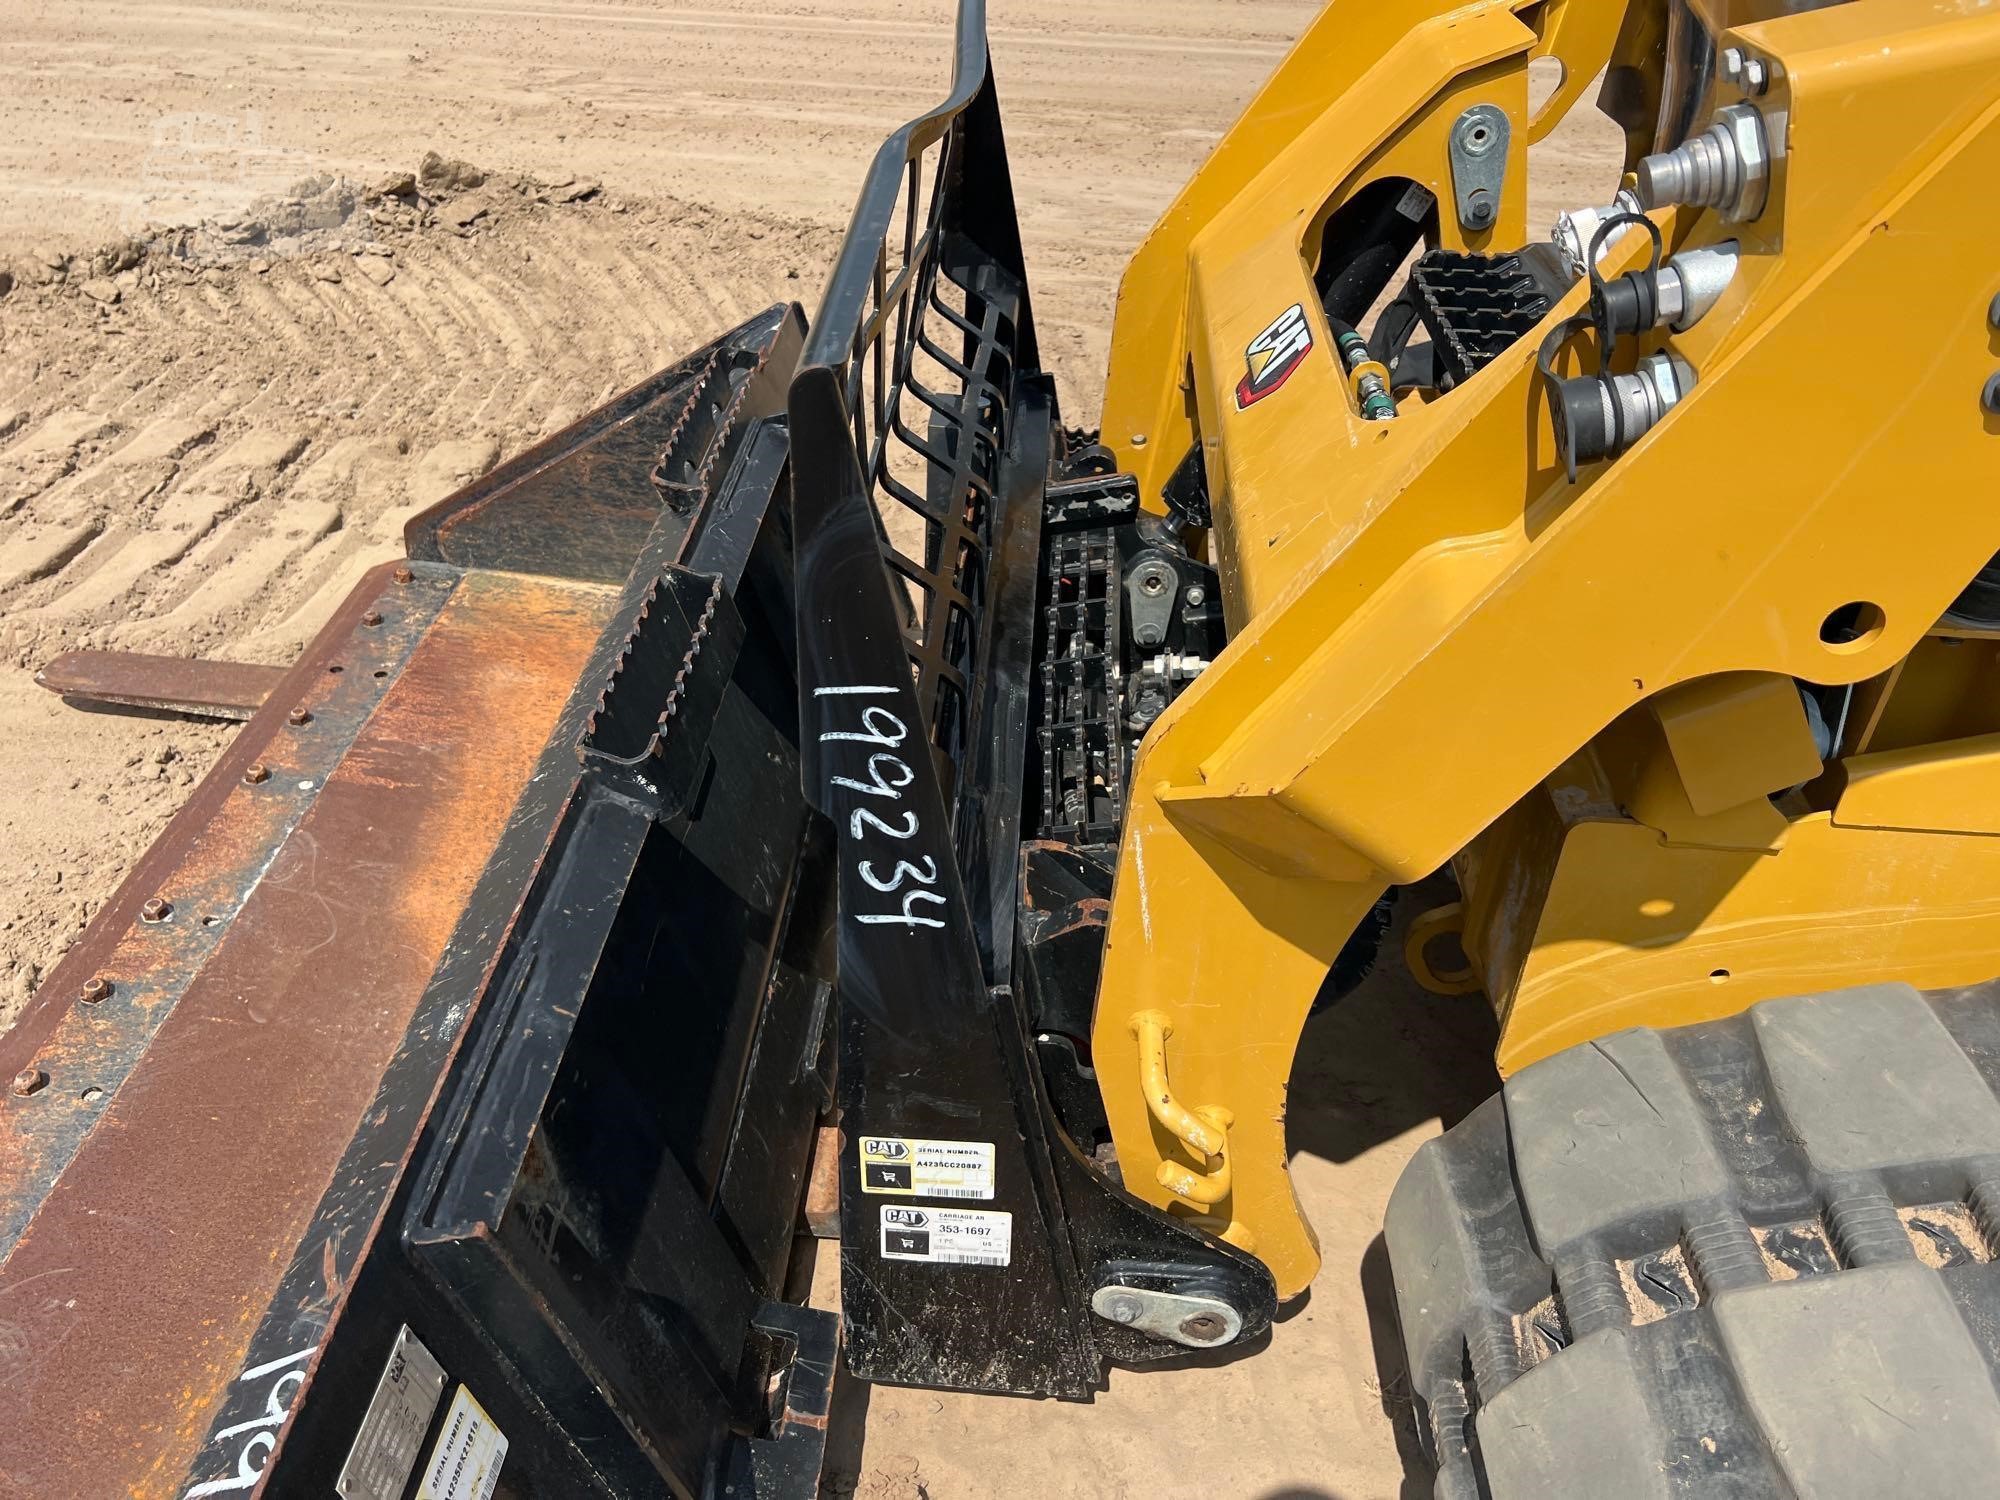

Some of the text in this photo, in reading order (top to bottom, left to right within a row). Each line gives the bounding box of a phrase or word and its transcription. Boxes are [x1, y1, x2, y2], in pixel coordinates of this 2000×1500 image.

[1246, 304, 1311, 386] CAT
[813, 685, 946, 928] 199234
[866, 1140, 900, 1158] CAT
[886, 1209, 919, 1225] CAT
[938, 1212, 972, 1220] CARRIAGE
[938, 1224, 992, 1236] 353-1697
[391, 1350, 407, 1383] CAT
[432, 1411, 464, 1489] SERIAL NUMBER
